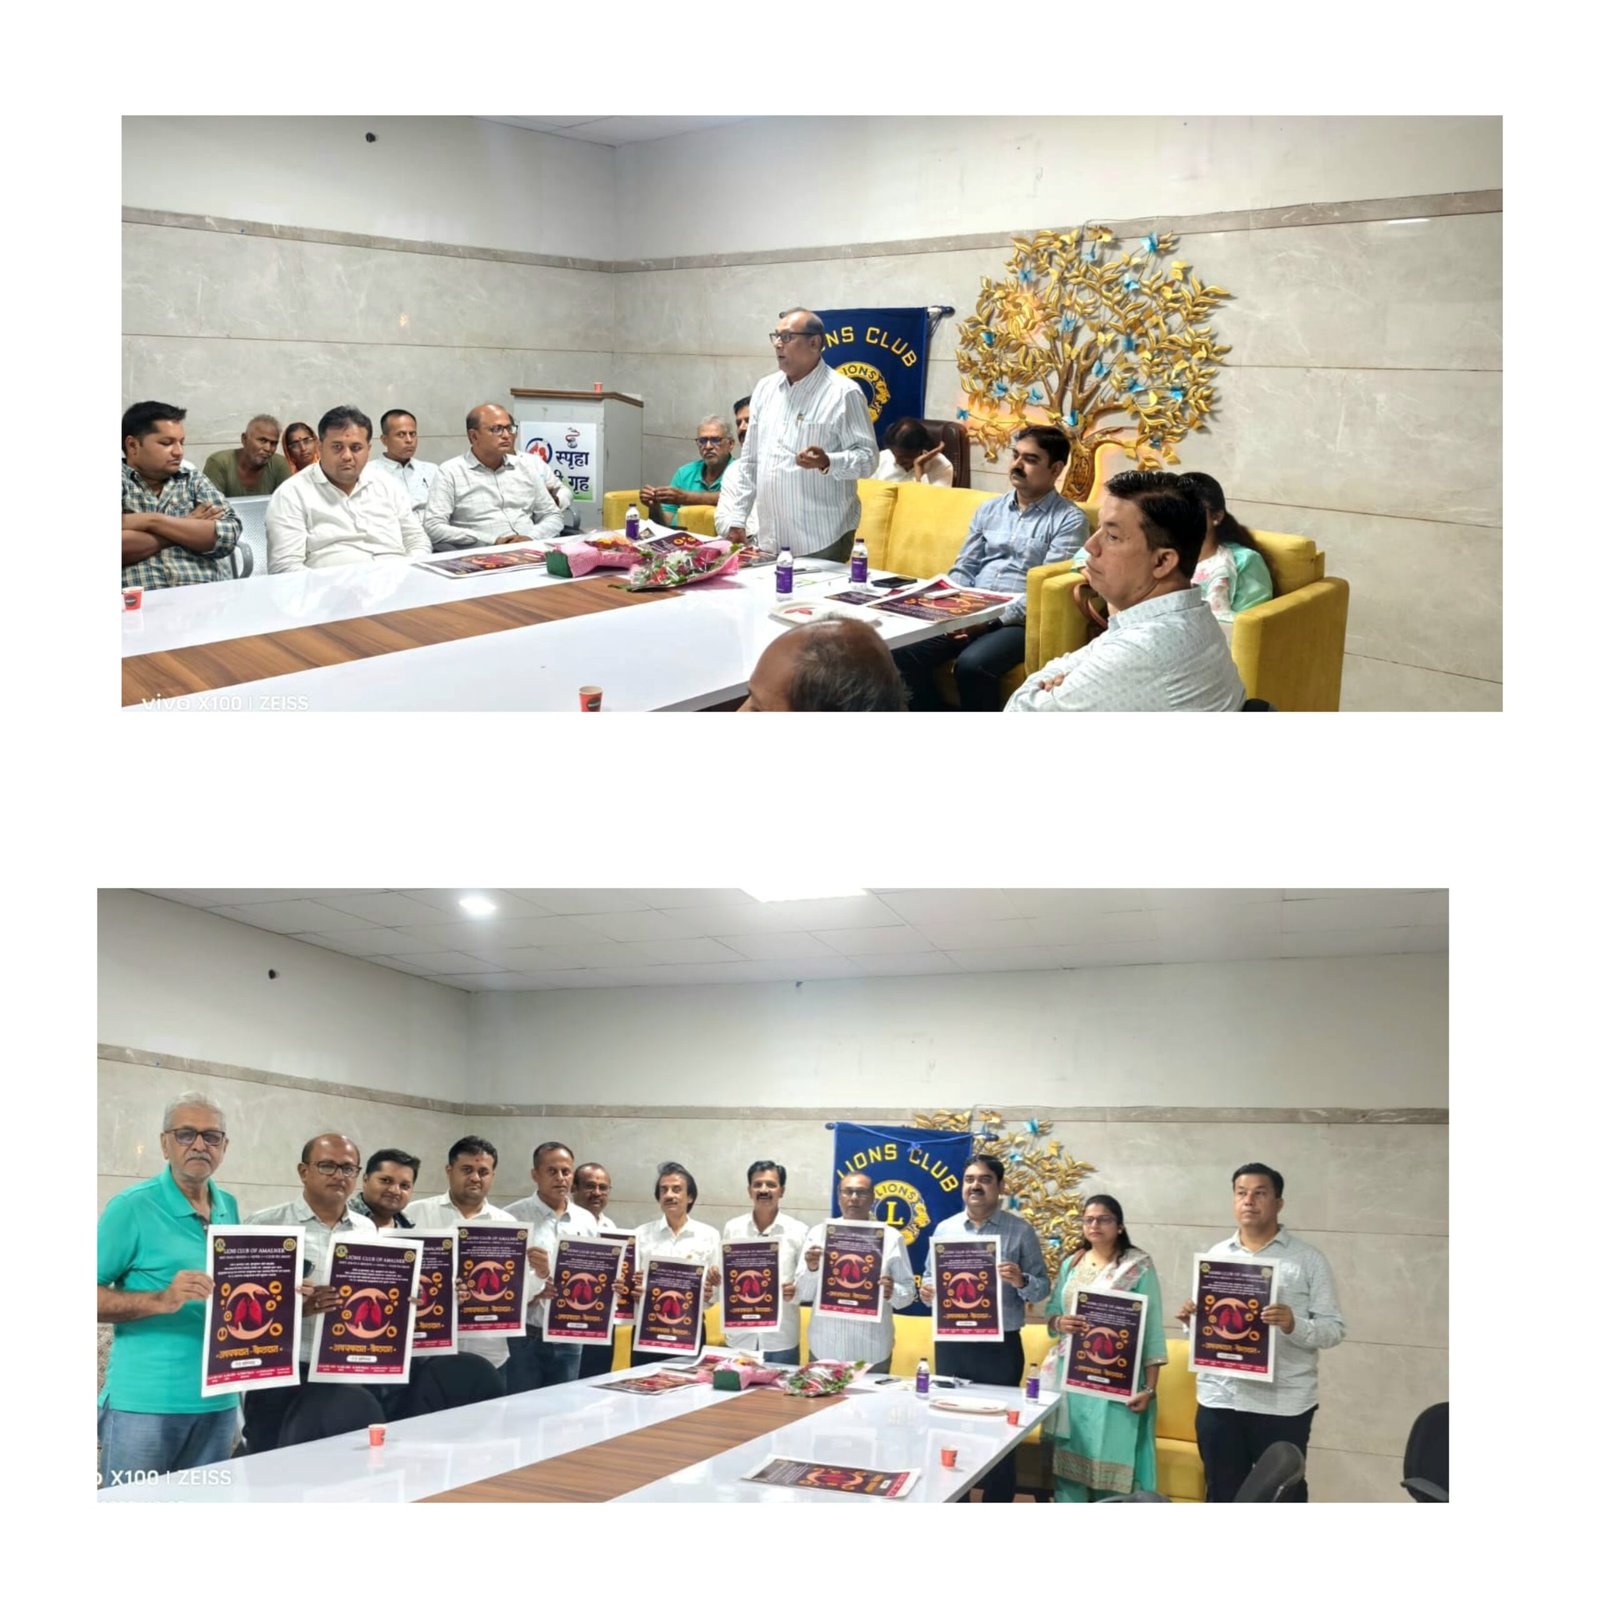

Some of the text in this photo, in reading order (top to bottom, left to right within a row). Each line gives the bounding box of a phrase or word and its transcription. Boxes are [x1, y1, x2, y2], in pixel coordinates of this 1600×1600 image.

[865, 326, 918, 367] CLUB
[842, 364, 877, 380] IONS
[555, 451, 589, 470] स्पृहा
[568, 476, 590, 495] गृह
[908, 1148, 960, 1193] CLUB
[875, 1185, 917, 1201] LIONS
[886, 1201, 905, 1226] L
